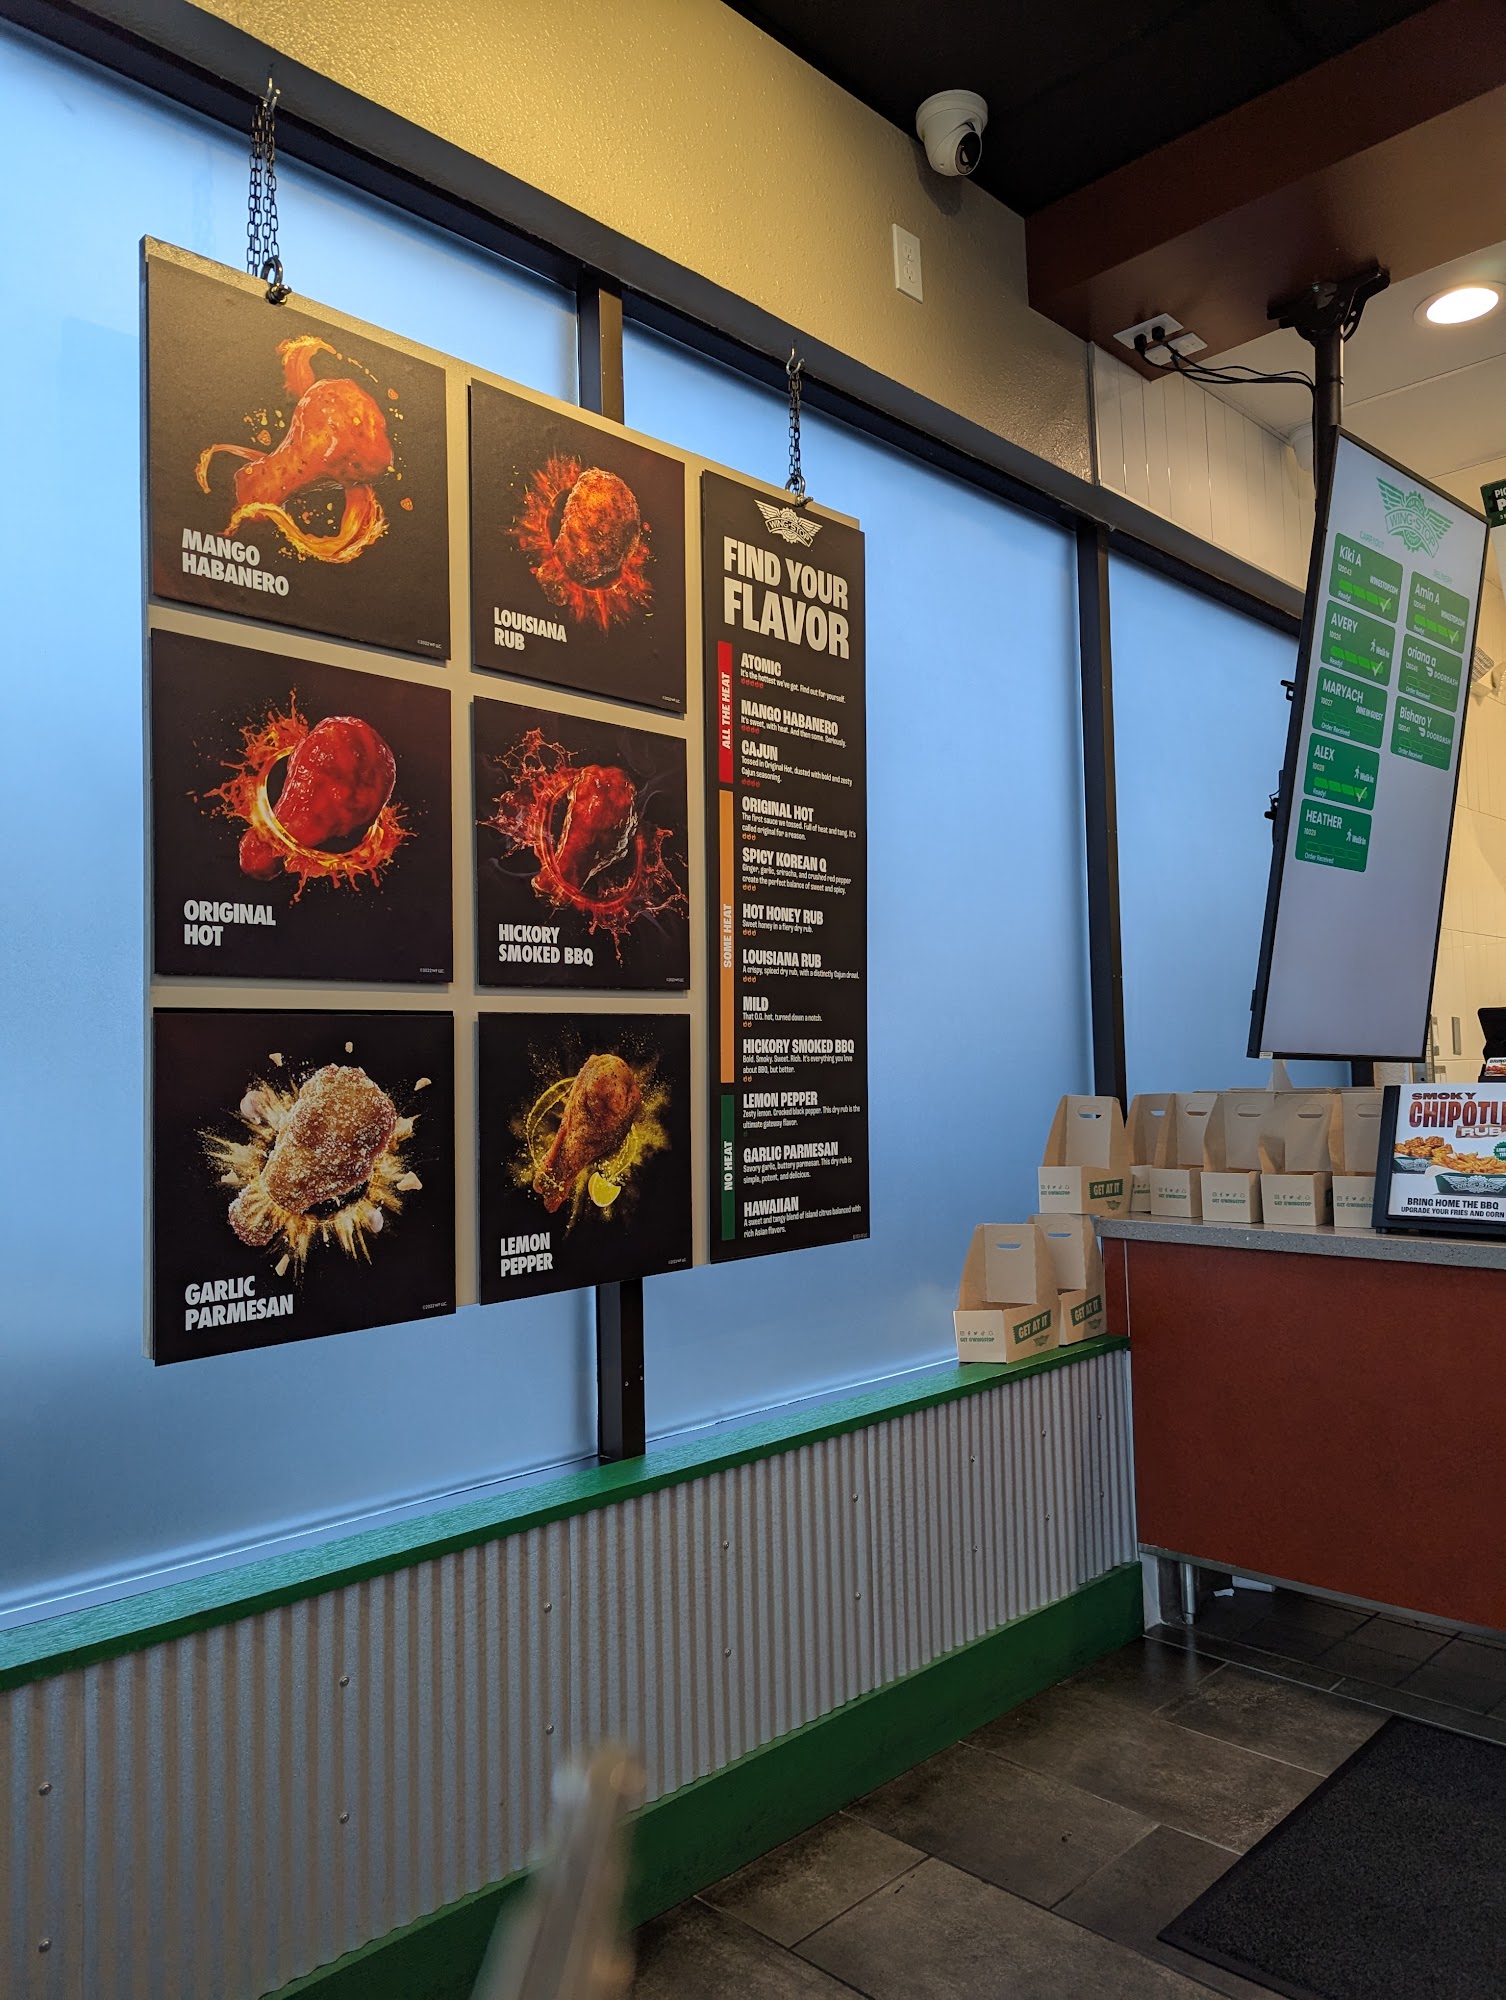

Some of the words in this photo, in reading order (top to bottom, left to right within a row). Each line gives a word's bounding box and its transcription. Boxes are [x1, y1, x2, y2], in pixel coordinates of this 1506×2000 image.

[182, 528, 260, 566] MANGO
[1340, 545, 1356, 563] Kiki
[1356, 554, 1362, 567] A
[182, 552, 290, 596] HABANERO
[724, 536, 782, 587] FIND
[785, 558, 848, 610] YOUR
[1415, 584, 1434, 602] Amin
[1434, 593, 1440, 606] A
[494, 606, 568, 643] LOUISIANA
[724, 576, 850, 660] FLAVOR
[1330, 612, 1358, 634] AVERY
[494, 627, 526, 651] RUB
[741, 652, 782, 678] ATOMIC
[1408, 646, 1431, 665] oriana
[1432, 657, 1436, 668] a
[722, 672, 731, 703] HEAT
[740, 668, 748, 678] It's
[749, 671, 757, 680] the
[758, 673, 776, 685] hottest
[777, 678, 790, 689] we've
[790, 683, 799, 693] got.
[800, 684, 809, 694] Find
[810, 688, 818, 696] out
[826, 691, 845, 705] yourself.
[1434, 671, 1458, 686] DOORDASH
[1322, 678, 1364, 704] MARYACH
[722, 703, 731, 727] THE
[741, 699, 781, 723] MANGO
[783, 709, 838, 737] HABANERO
[1400, 706, 1426, 726] Bisharo
[1427, 716, 1432, 728] Y
[722, 727, 731, 749] ALL
[741, 715, 749, 725] It's
[750, 718, 765, 729] sweet,
[766, 721, 777, 731] with
[778, 724, 789, 734] heat.
[791, 727, 799, 736] And
[800, 729, 810, 739] then
[811, 733, 824, 742] some.
[825, 735, 846, 749] Seriously.
[1321, 722, 1333, 732] Order
[1334, 726, 1350, 736] Received
[1426, 730, 1451, 746] DOORDASH
[742, 739, 778, 761] CAJUN
[1314, 744, 1335, 761] ALEX
[1312, 788, 1326, 798] Ready!
[742, 796, 792, 819] ORIGINAL
[794, 805, 814, 822] HOT
[1306, 809, 1342, 830] HEATHER
[742, 847, 774, 866] SPICY
[776, 852, 818, 872] KOREAN
[819, 858, 827, 873] Q
[1304, 852, 1316, 860] Order
[1317, 854, 1334, 864] Received
[184, 900, 276, 926] ORIGINAL
[723, 904, 732, 933] HEAT
[743, 903, 764, 920] HOT
[766, 906, 801, 923] HONEY
[803, 910, 823, 925] RUB
[184, 924, 223, 946] HOT
[498, 924, 560, 944] HICKORY
[742, 919, 757, 928] Sweet
[758, 921, 772, 931] honey
[773, 922, 778, 930] in
[783, 923, 793, 933] fiery
[794, 924, 802, 934] dry
[803, 925, 813, 933] rub.
[498, 944, 560, 964] SMOKED
[564, 947, 594, 966] BBQ
[724, 935, 732, 968] SOME
[743, 949, 799, 966] LOUISIANA
[801, 953, 821, 968] RUB
[743, 996, 769, 1011] MILD
[743, 1039, 790, 1054] HICKORY
[792, 1039, 833, 1054] SMOKED
[835, 1040, 854, 1054] BBQ
[743, 1055, 755, 1063] Bold.
[756, 1055, 773, 1065] Smoky.
[774, 1055, 790, 1063] Sweet.
[811, 1054, 835, 1064] everything
[835, 1056, 843, 1064] you
[844, 1054, 852, 1062] love
[743, 1066, 757, 1074] about
[758, 1066, 769, 1074] BBQ,
[779, 1065, 795, 1073] better.
[743, 1092, 778, 1109] LEMON
[781, 1091, 818, 1107] PEPPER
[1412, 1092, 1477, 1100] SMOKY
[1461, 1126, 1501, 1136] RUB
[724, 1141, 733, 1171] HEAT
[743, 1146, 782, 1164] GARLIC
[784, 1142, 838, 1160] PARMESAN
[724, 1173, 733, 1191] NO
[744, 1175, 761, 1186] simple,
[762, 1174, 779, 1184] potent,
[780, 1172, 789, 1180] and
[789, 1170, 811, 1179] delicious.
[1094, 1184, 1104, 1196] GET
[1106, 1184, 1114, 1194] AT
[1114, 1182, 1120, 1192] IT
[744, 1196, 799, 1218] HAWAIIAN
[1400, 1206, 1430, 1214] UPGRADE
[1432, 1208, 1449, 1216] YOUR
[1486, 1210, 1504, 1218] CORN
[1407, 1198, 1434, 1207] BRING
[1435, 1199, 1460, 1208] HOME
[1462, 1200, 1478, 1209] THE
[1480, 1201, 1498, 1210] BBQ
[500, 1232, 550, 1256] LEMON
[501, 1252, 553, 1278] PEPPER
[185, 1276, 256, 1306] GARLIC
[185, 1294, 294, 1331] PARMESAN
[1074, 1308, 1086, 1322] GET
[1086, 1303, 1094, 1316] AT
[1094, 1300, 1099, 1312] IT
[1018, 1325, 1031, 1338] GET
[1032, 1319, 1041, 1333] AT
[1042, 1314, 1048, 1330] IT
